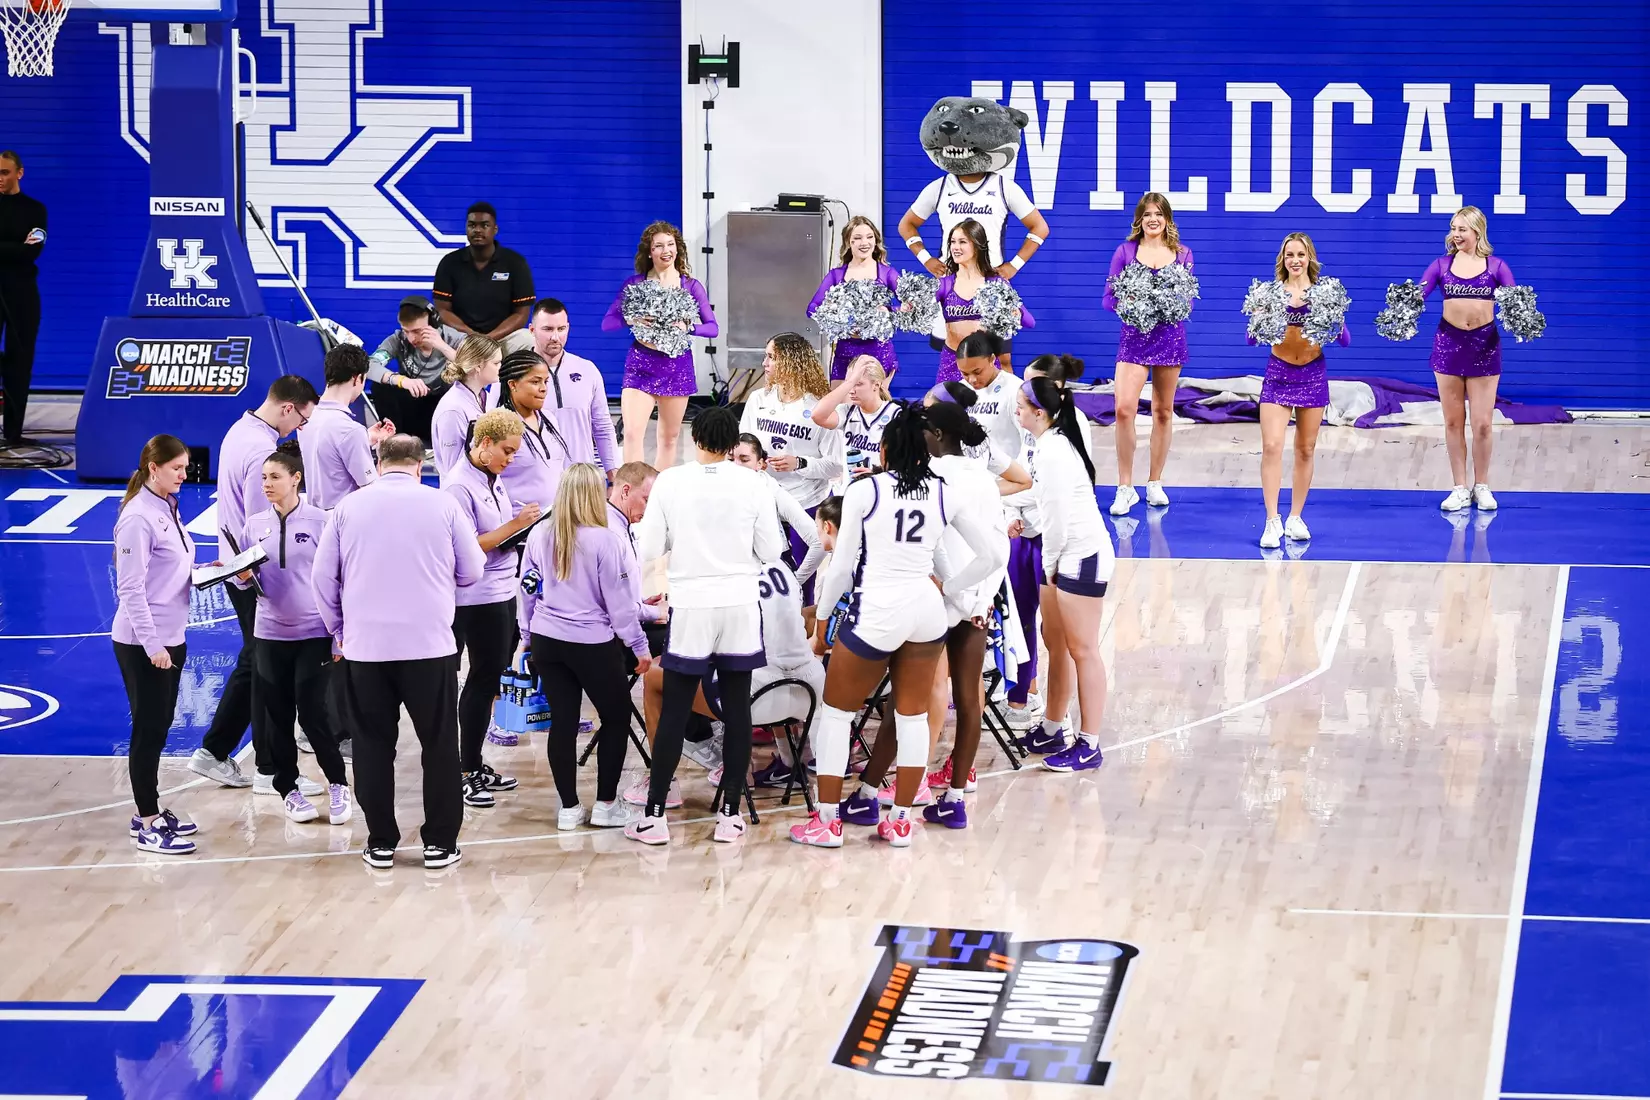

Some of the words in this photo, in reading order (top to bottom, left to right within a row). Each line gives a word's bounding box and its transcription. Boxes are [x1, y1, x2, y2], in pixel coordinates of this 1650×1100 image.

[971, 81, 1629, 215] WILDCATS
[154, 202, 219, 212] NISSAN
[948, 202, 993, 215] Wildcats
[157, 239, 218, 289] UK
[146, 292, 231, 307] HealthCare
[1444, 283, 1492, 297] Wildcats
[140, 344, 213, 365] MARCH
[149, 365, 246, 387] MADNESS
[756, 417, 789, 436] NOTHING
[789, 422, 812, 441] EASY.
[894, 508, 926, 543] 12
[995, 960, 1112, 1043] MARCH
[874, 967, 1007, 1080] MADNESS
